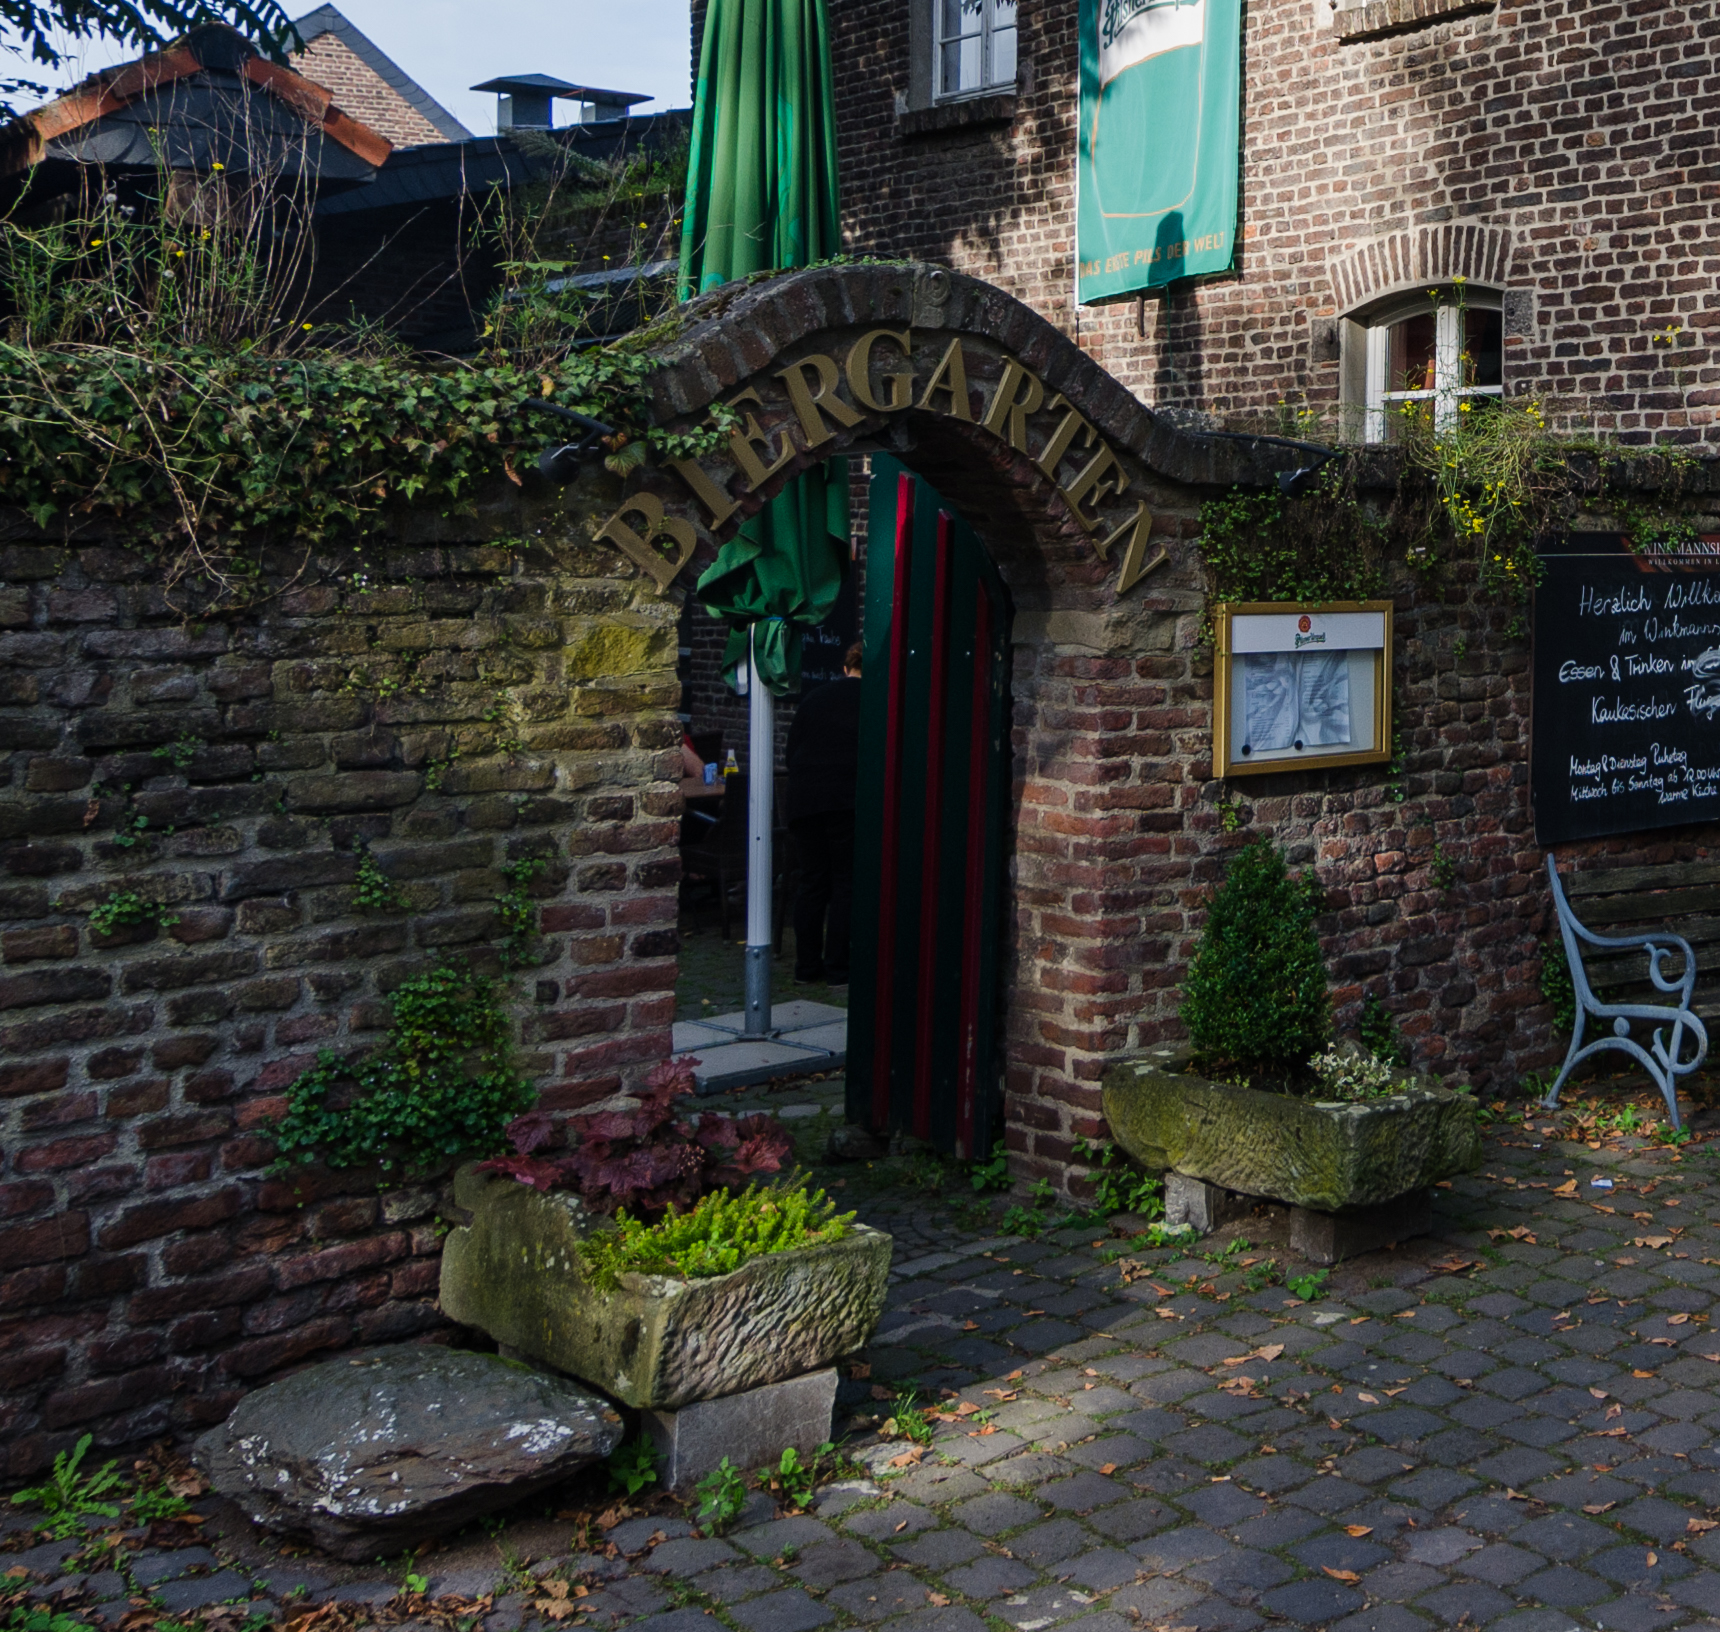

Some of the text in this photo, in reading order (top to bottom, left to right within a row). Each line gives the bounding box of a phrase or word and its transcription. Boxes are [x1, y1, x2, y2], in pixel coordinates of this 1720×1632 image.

[1079, 260, 1101, 279] DAS
[1134, 246, 1162, 266] PILS
[1167, 240, 1191, 260] DER
[1194, 231, 1225, 253] WELT
[592, 328, 1172, 596] BIERGARTEN
[1648, 558, 1701, 566] WILLKOMMEN
[1579, 584, 1652, 616] Herzlich
[1618, 625, 1637, 646] im
[1558, 659, 1605, 683] Essen
[1609, 654, 1621, 682] &
[1624, 652, 1675, 677] Trinken
[1591, 696, 1677, 724] Kaukasischen
[1650, 742, 1688, 771] Ruhetag
[1570, 782, 1608, 802] Mittwoch
[1612, 777, 1625, 794] bis
[1628, 773, 1664, 792] Sonntag
[1667, 769, 1678, 783] ab
[1658, 788, 1689, 805] warme
